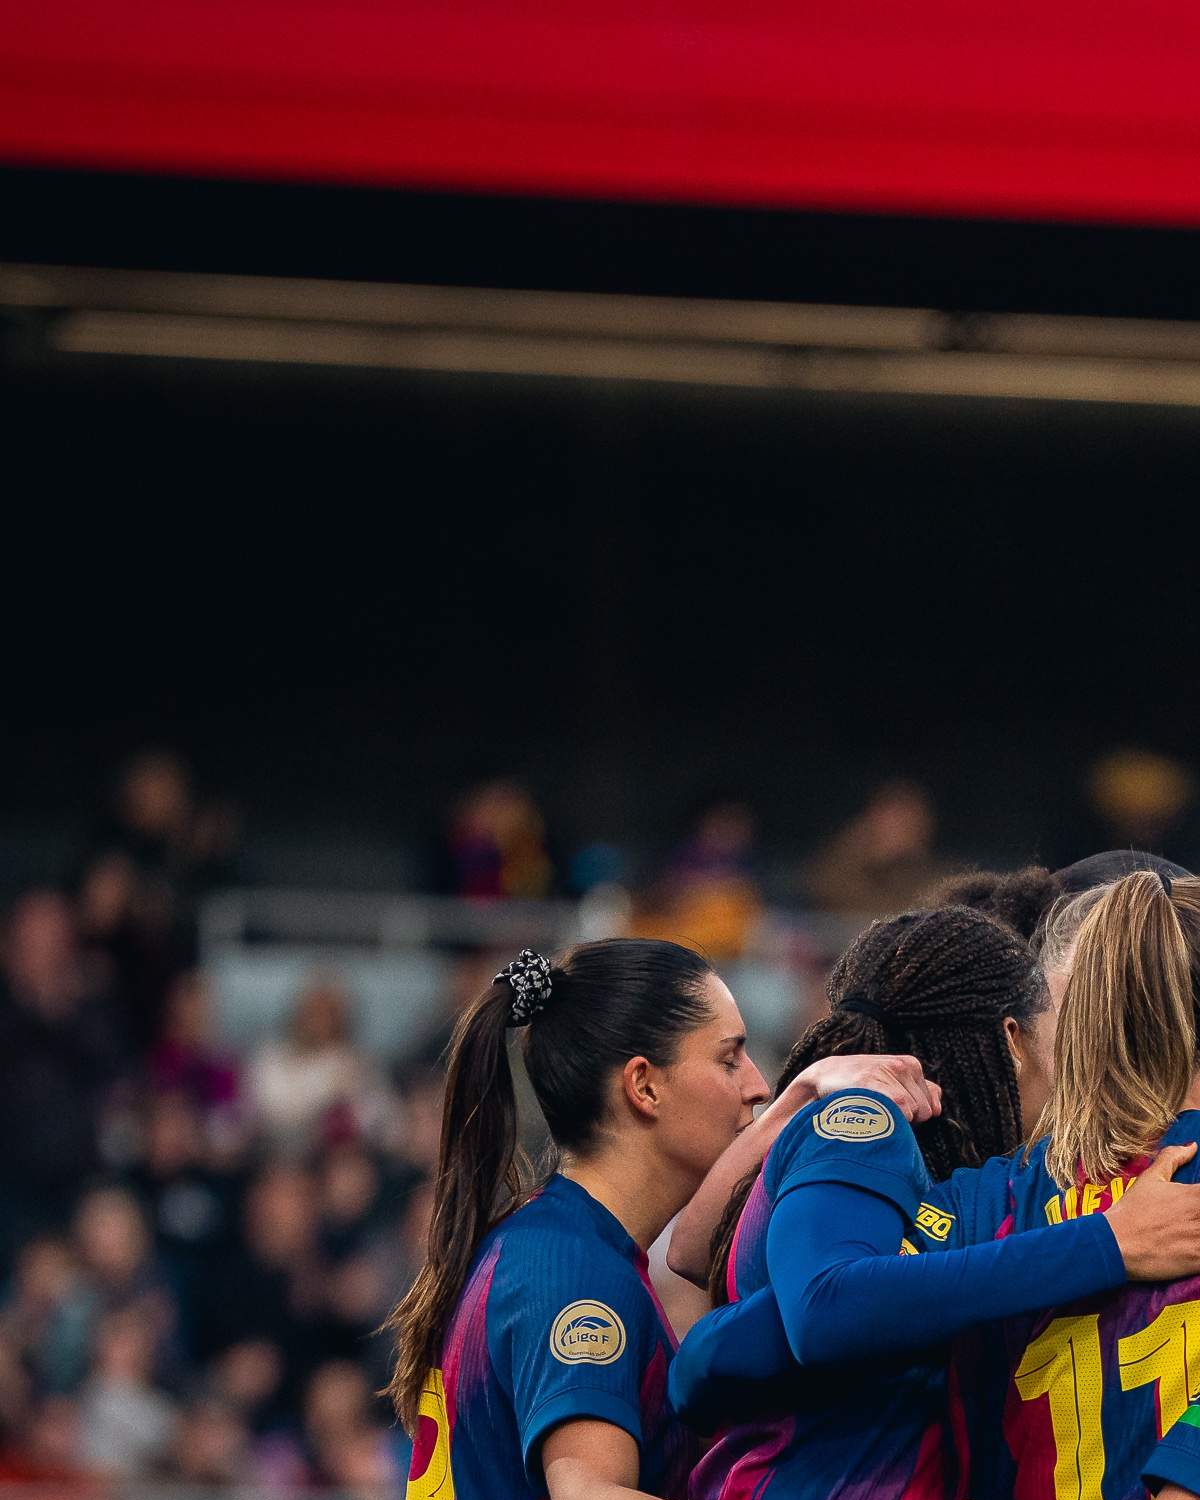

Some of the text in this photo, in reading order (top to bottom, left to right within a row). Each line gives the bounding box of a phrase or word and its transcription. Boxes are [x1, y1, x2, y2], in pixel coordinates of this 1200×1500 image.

[834, 1115, 878, 1126] Liga F
[569, 1332, 610, 1345] Liga F
